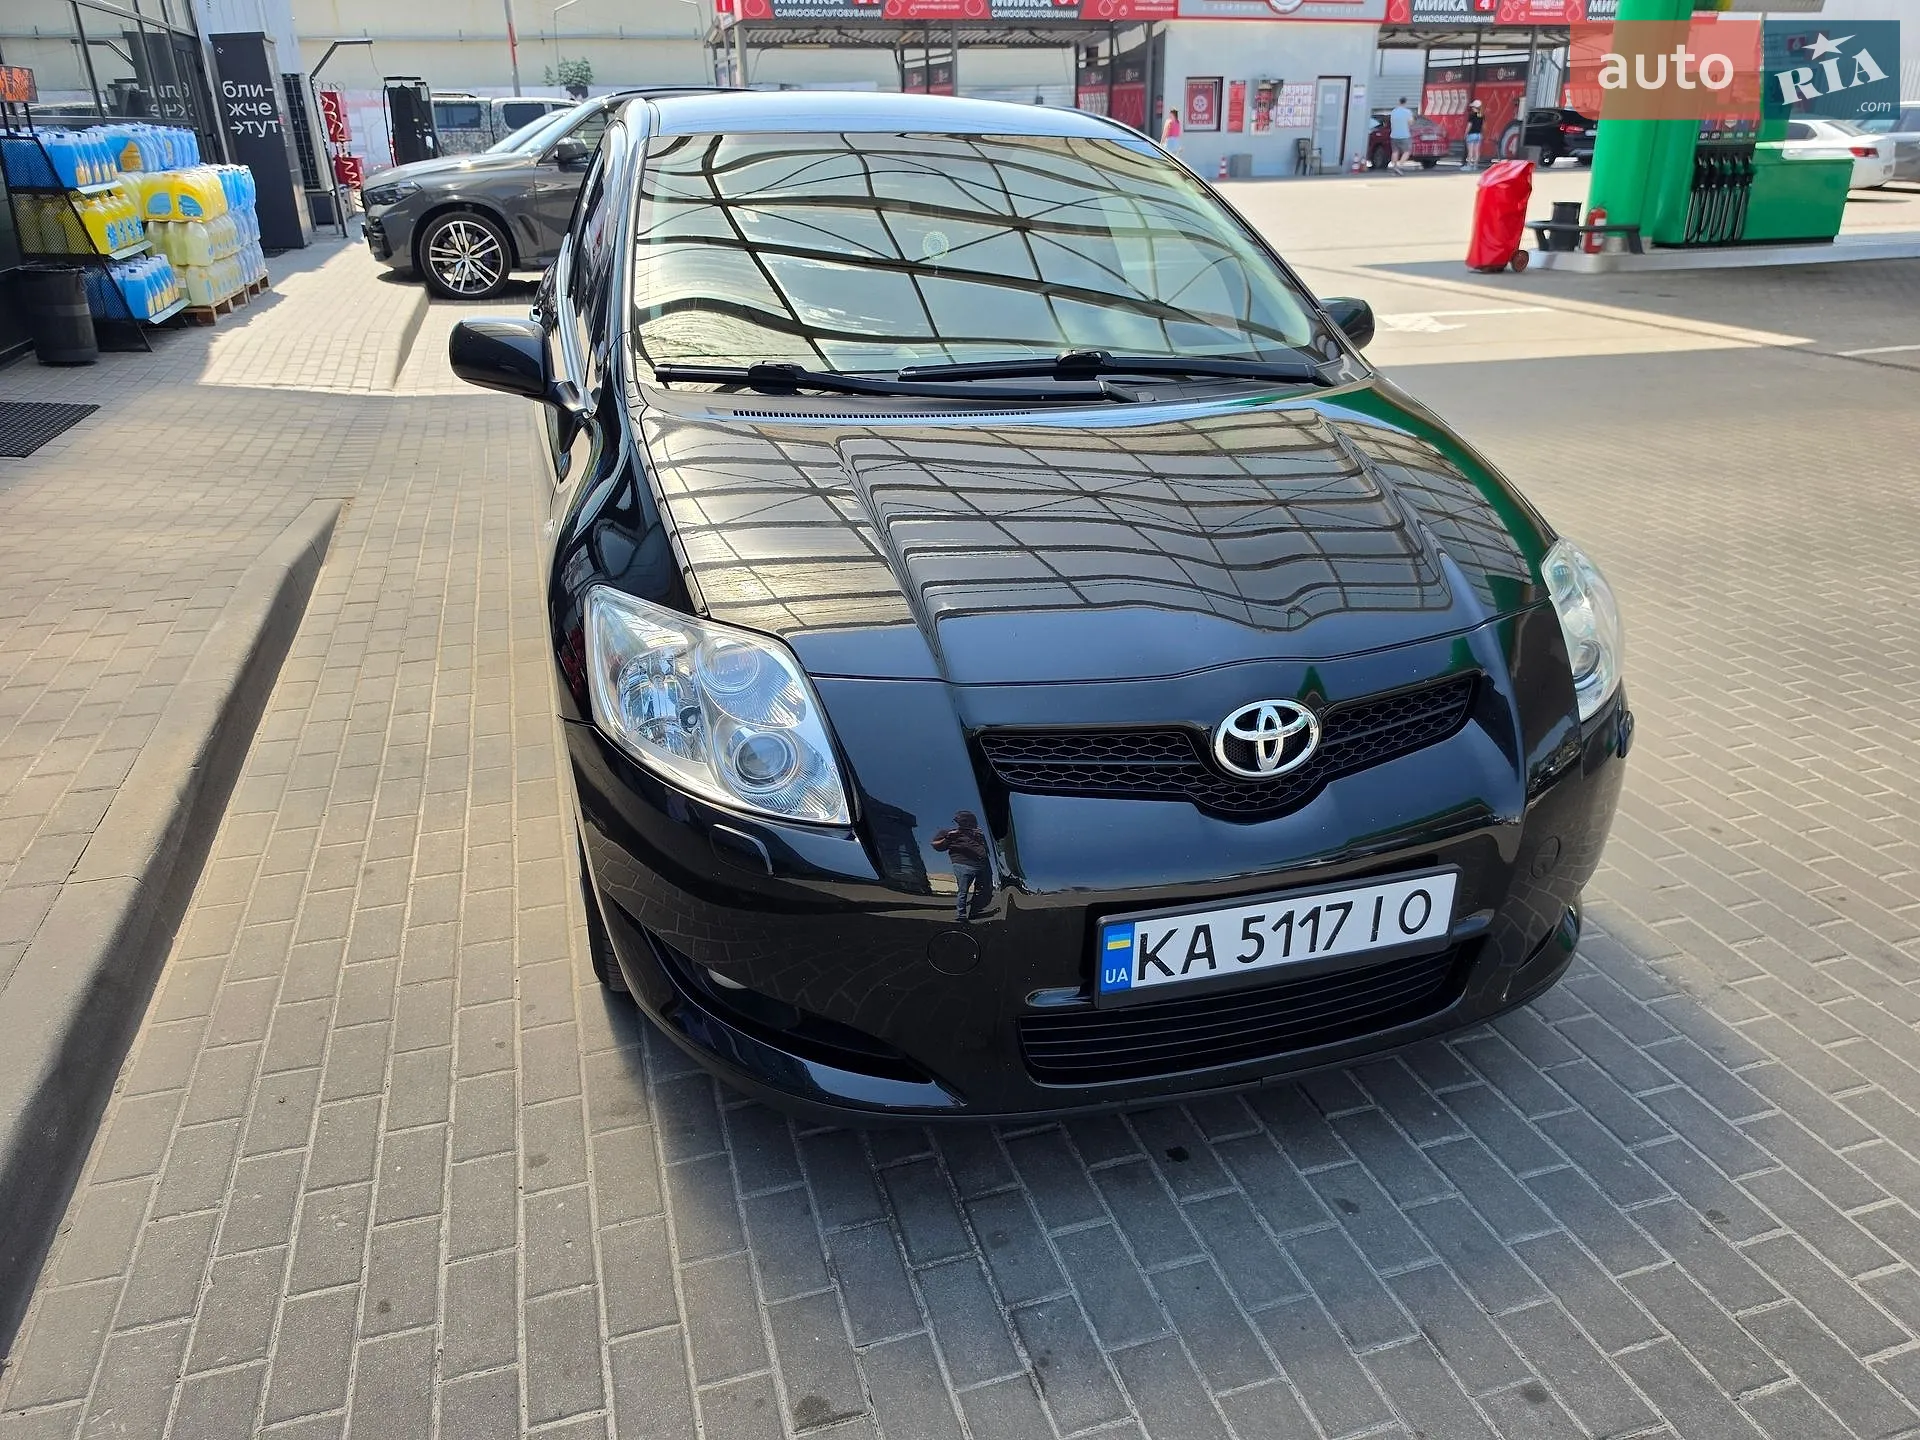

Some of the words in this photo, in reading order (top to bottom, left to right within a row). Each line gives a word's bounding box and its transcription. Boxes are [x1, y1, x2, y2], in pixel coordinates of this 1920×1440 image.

[222, 80, 274, 98] бли-
[227, 101, 272, 116] жче
[242, 120, 279, 138] тут
[1236, 901, 1354, 964] 5117
[1105, 966, 1129, 984] UA
